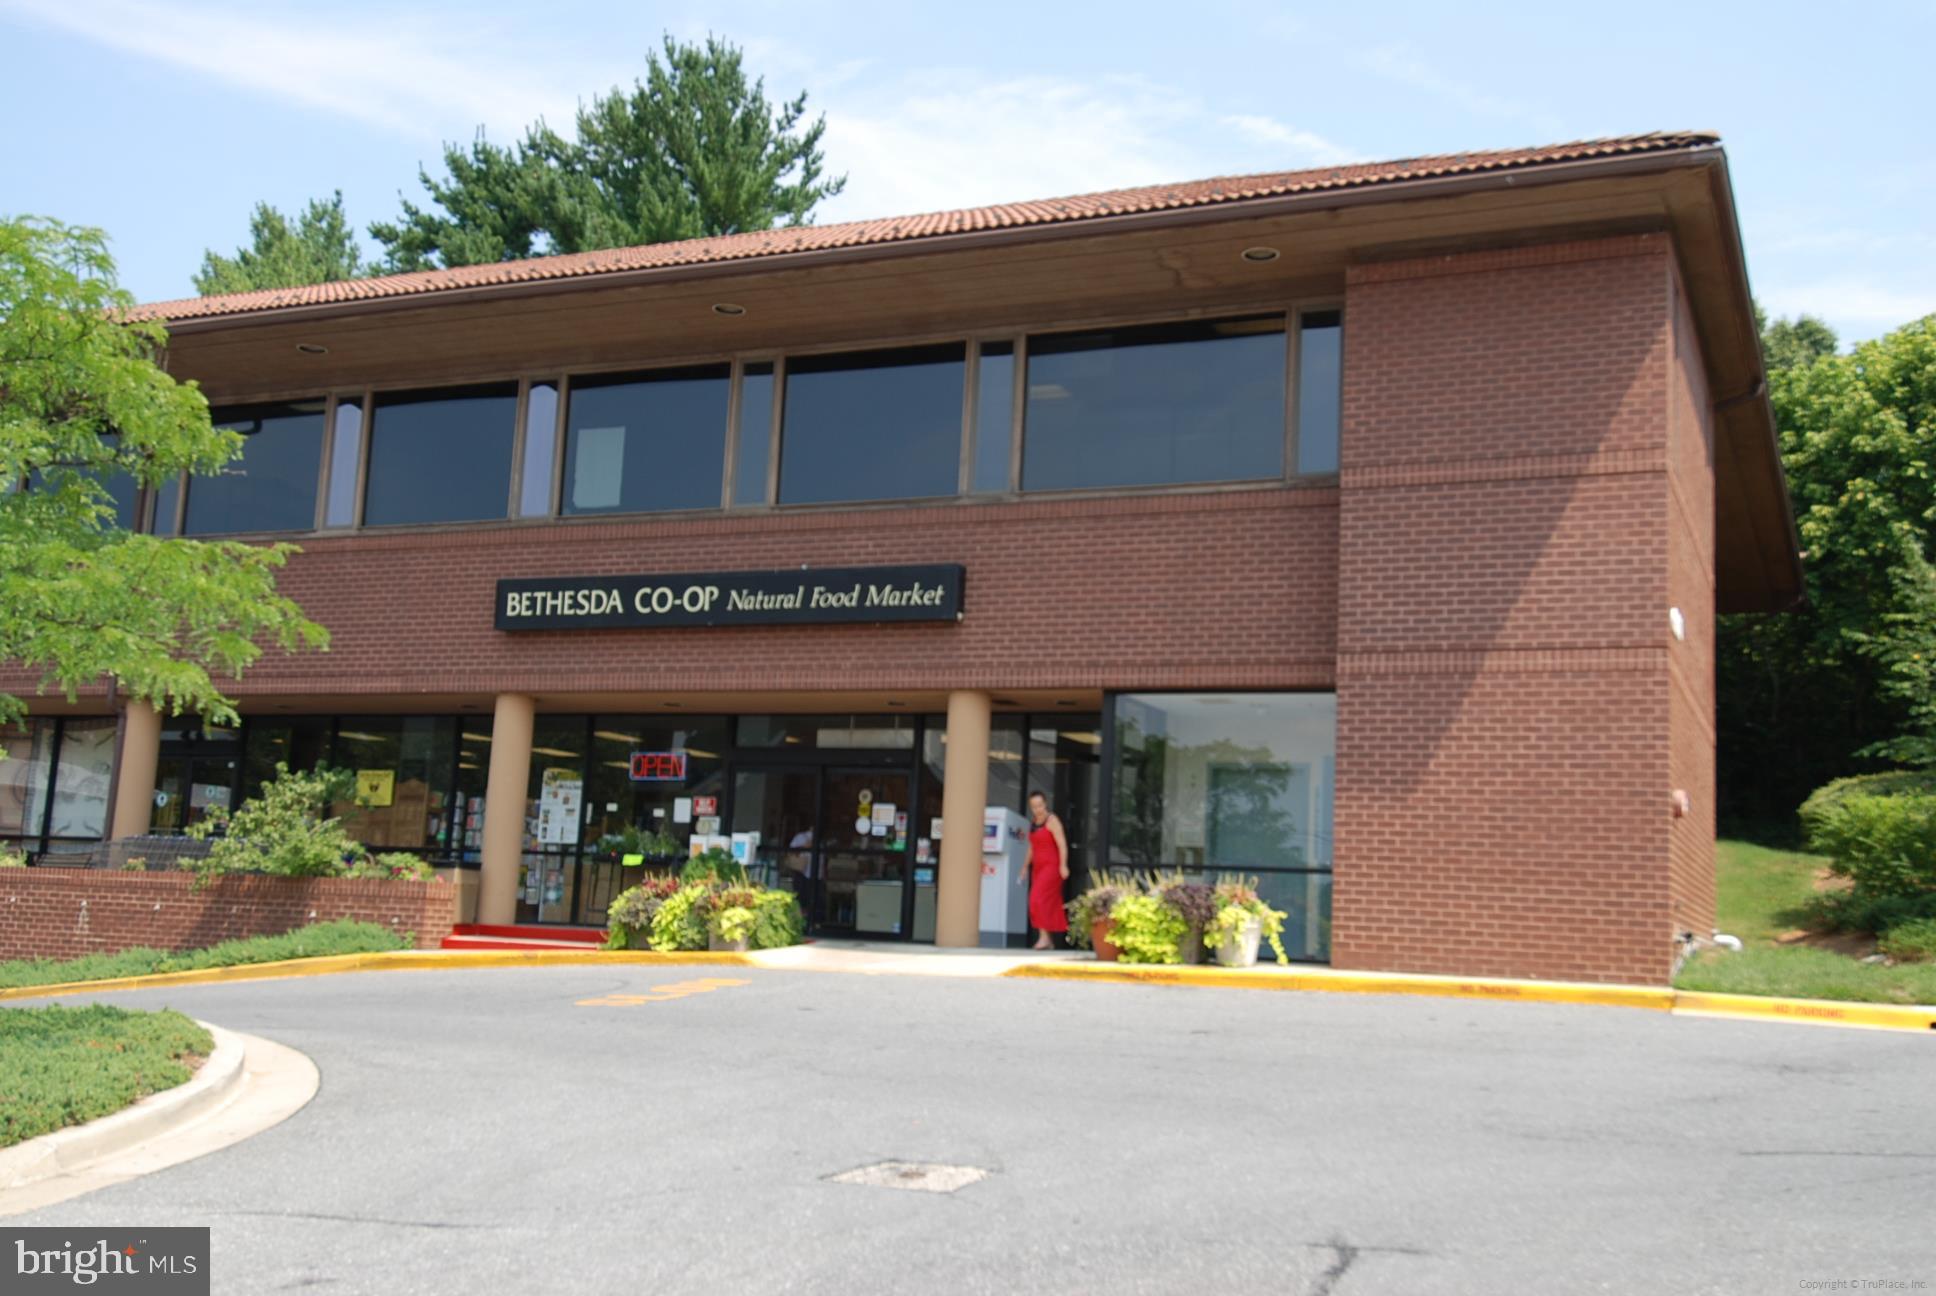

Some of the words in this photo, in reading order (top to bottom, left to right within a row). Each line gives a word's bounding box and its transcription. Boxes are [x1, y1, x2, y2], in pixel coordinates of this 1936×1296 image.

[506, 589, 624, 617] BETHESDA
[634, 586, 720, 614] CO-OP
[726, 585, 805, 612] Natural
[809, 583, 861, 609] Food
[864, 582, 945, 608] Market
[632, 753, 684, 778] OPEN
